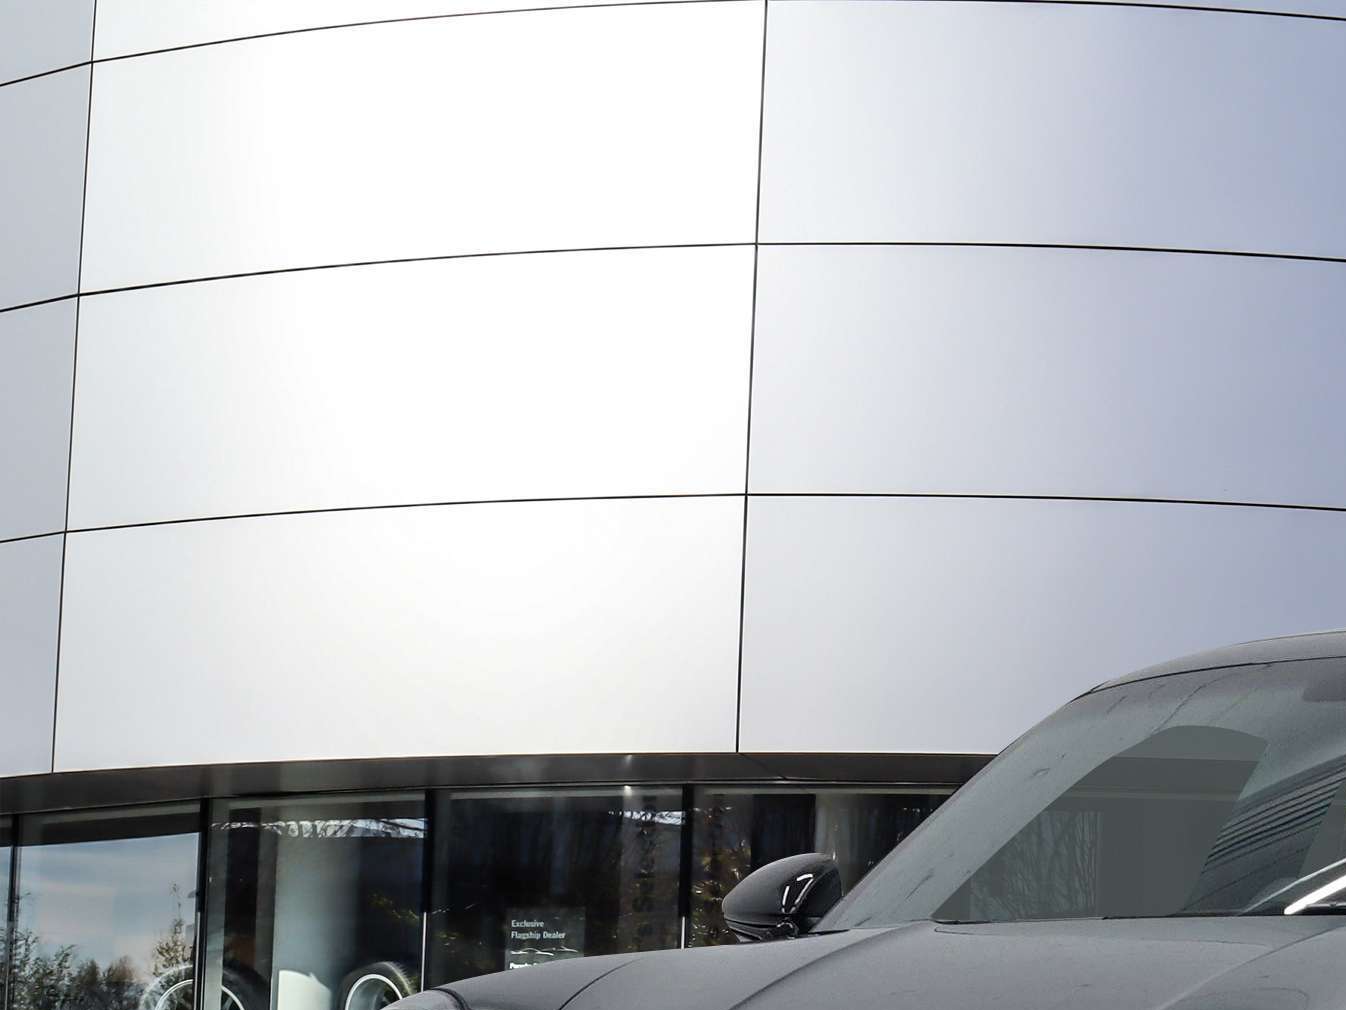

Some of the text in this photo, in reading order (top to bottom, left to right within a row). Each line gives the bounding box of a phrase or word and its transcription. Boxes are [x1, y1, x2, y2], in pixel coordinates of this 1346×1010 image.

[511, 919, 545, 928] Exclusive
[511, 930, 566, 940] Flagship Dealer
